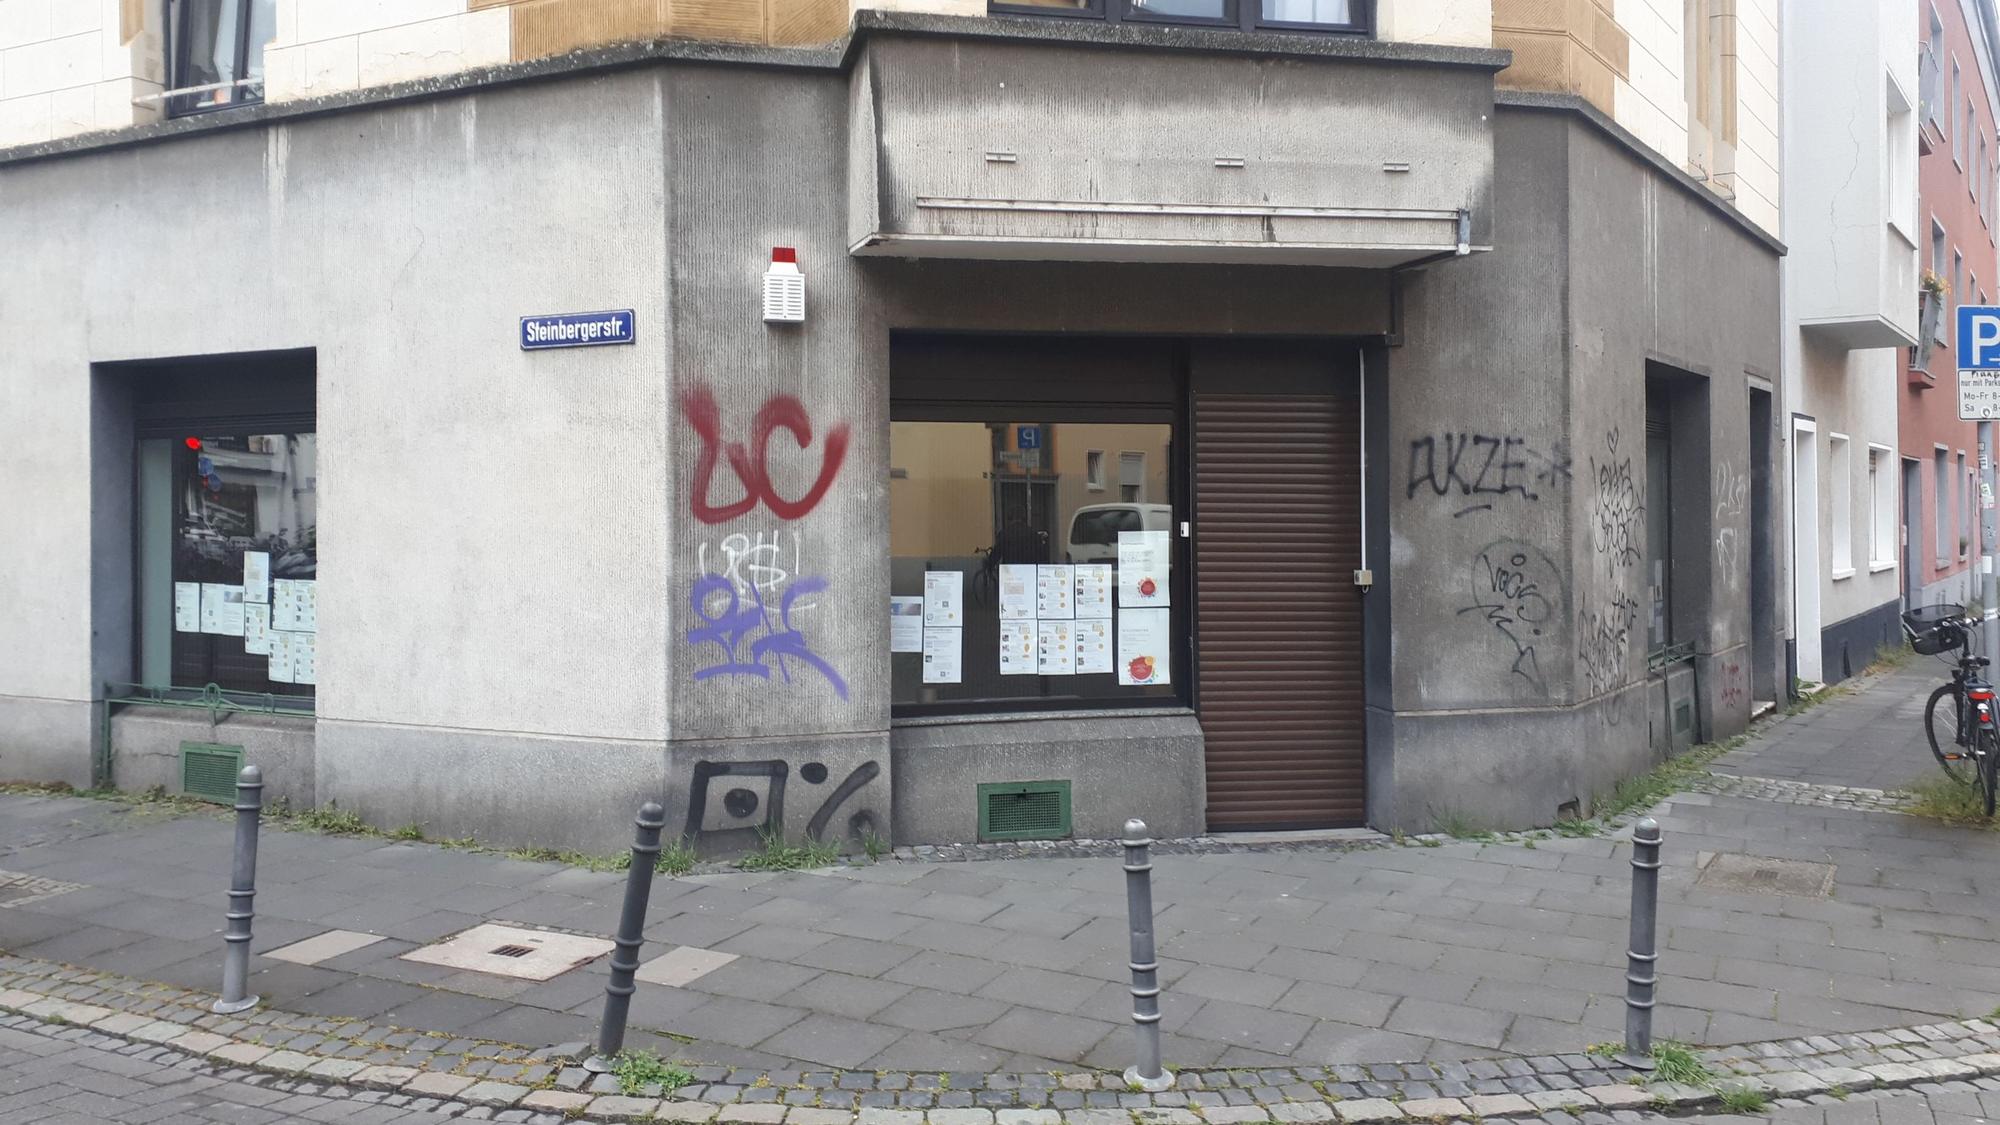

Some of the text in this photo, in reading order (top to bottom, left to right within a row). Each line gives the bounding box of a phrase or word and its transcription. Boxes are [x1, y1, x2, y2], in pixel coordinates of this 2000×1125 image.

[526, 316, 626, 342] Steinbergerstr.
[1971, 315, 2000, 366] P
[1963, 392, 1988, 400] Mo-Fr
[1964, 403, 1975, 412] Sa
